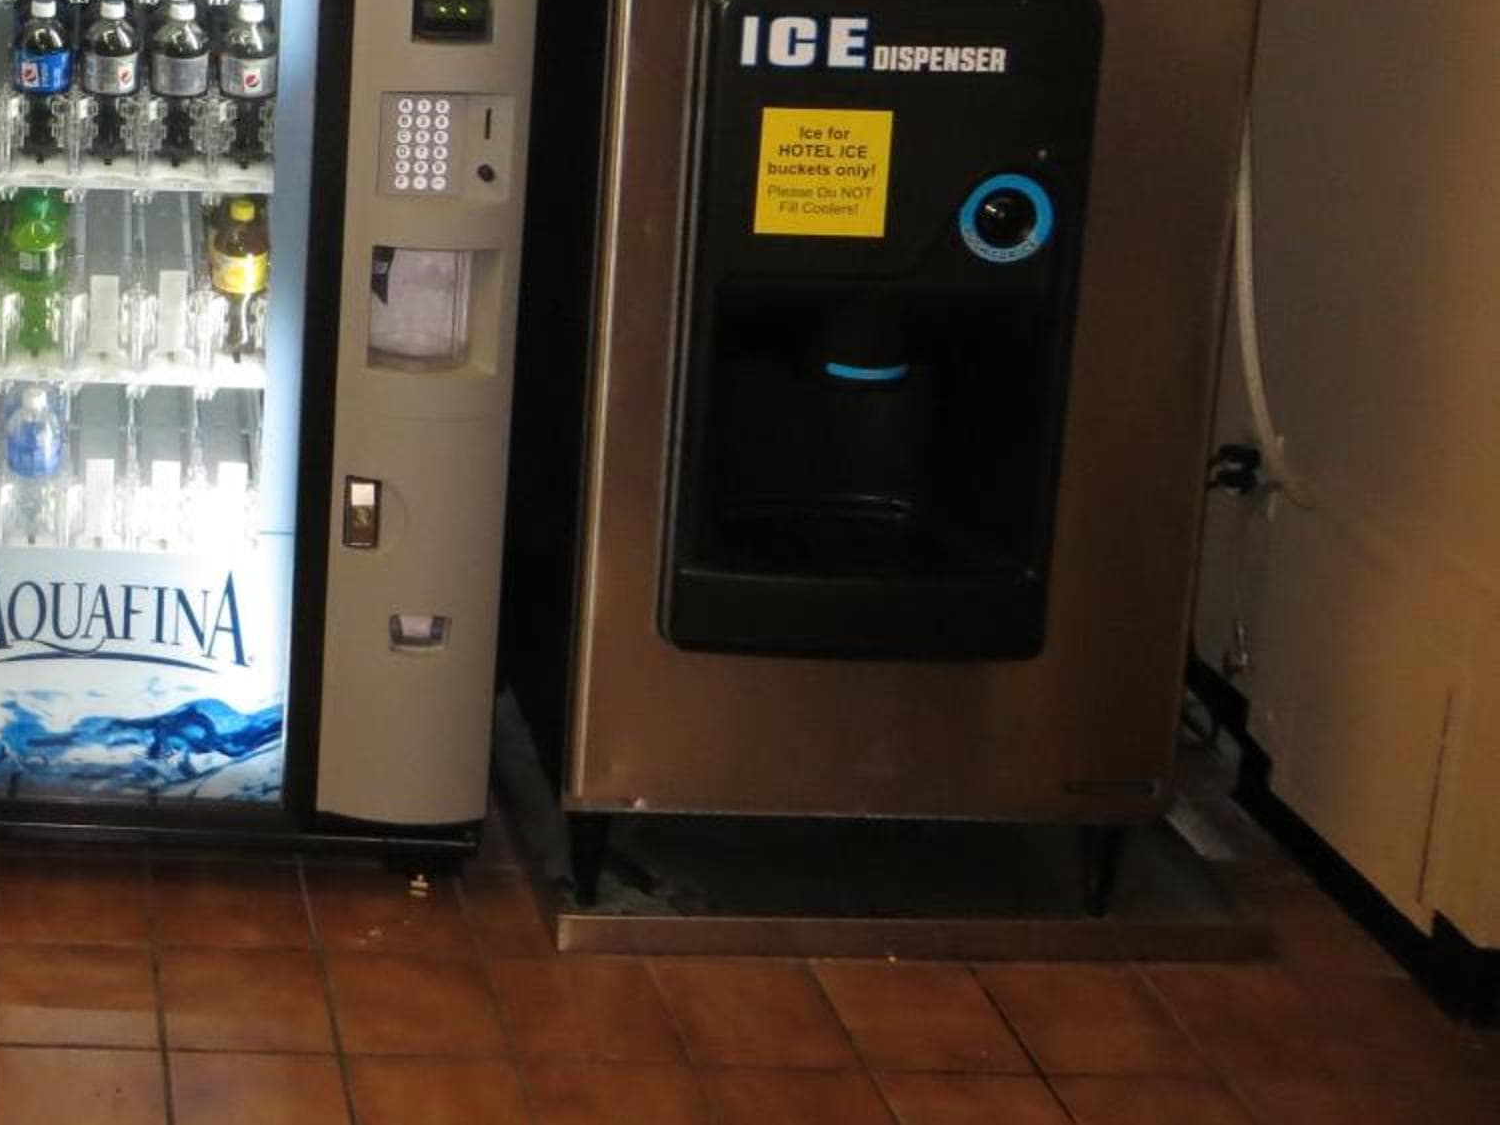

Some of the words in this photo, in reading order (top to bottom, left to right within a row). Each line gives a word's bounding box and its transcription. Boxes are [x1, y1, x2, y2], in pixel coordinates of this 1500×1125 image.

[740, 16, 869, 68] ICE
[872, 46, 1007, 73] DISPENSER
[799, 126, 823, 140] Ice
[827, 126, 851, 140] for
[778, 144, 835, 158] HOTEL
[840, 145, 868, 159] ICE
[767, 162, 830, 176] buckets
[835, 163, 876, 180] only!
[767, 185, 813, 198] Please
[817, 186, 837, 199] Do
[841, 186, 874, 200] NOT
[779, 201, 799, 213] Fill
[802, 202, 859, 216] Coolers!
